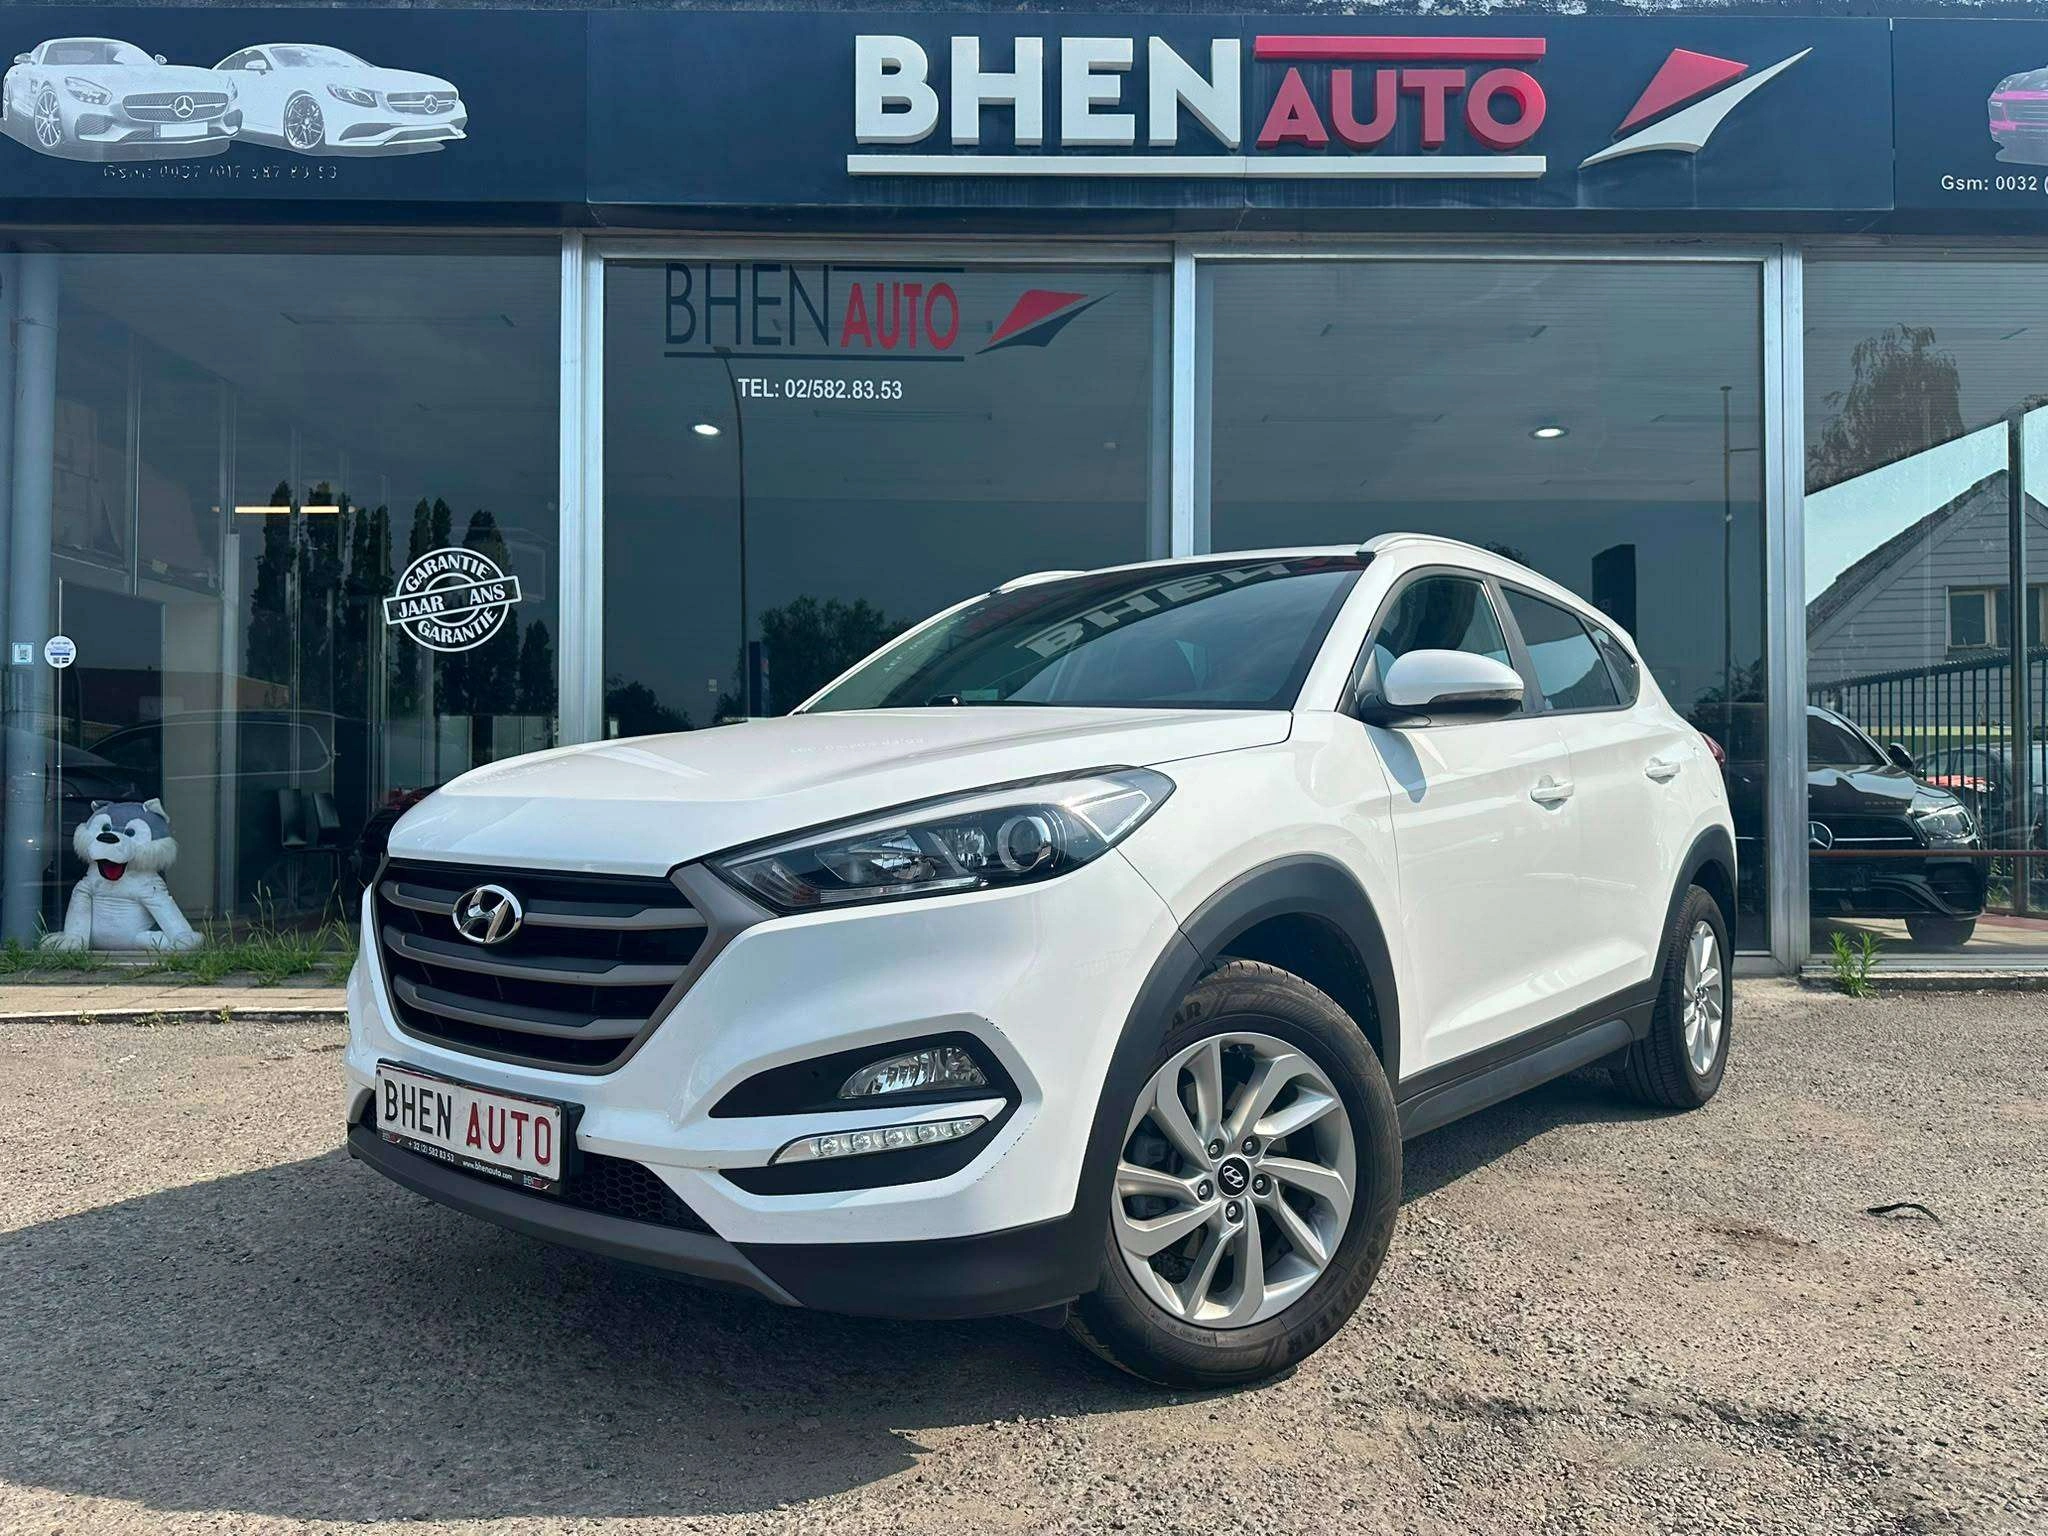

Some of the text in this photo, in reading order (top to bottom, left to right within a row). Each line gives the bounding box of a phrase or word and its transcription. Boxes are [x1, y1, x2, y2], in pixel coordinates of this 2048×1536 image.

[855, 35, 1547, 151] BHEN AUTO
[1941, 174, 1989, 191] Gsm:
[1995, 175, 2038, 191] 0032
[665, 263, 960, 350] BHEN AUTO
[738, 378, 903, 400] TEL: 02/582.83.53
[405, 554, 491, 592] GARANTIE
[398, 583, 506, 618] JAAR ANS
[417, 606, 498, 644] GARANTIE
[384, 1079, 551, 1165] BHEN AUTO
